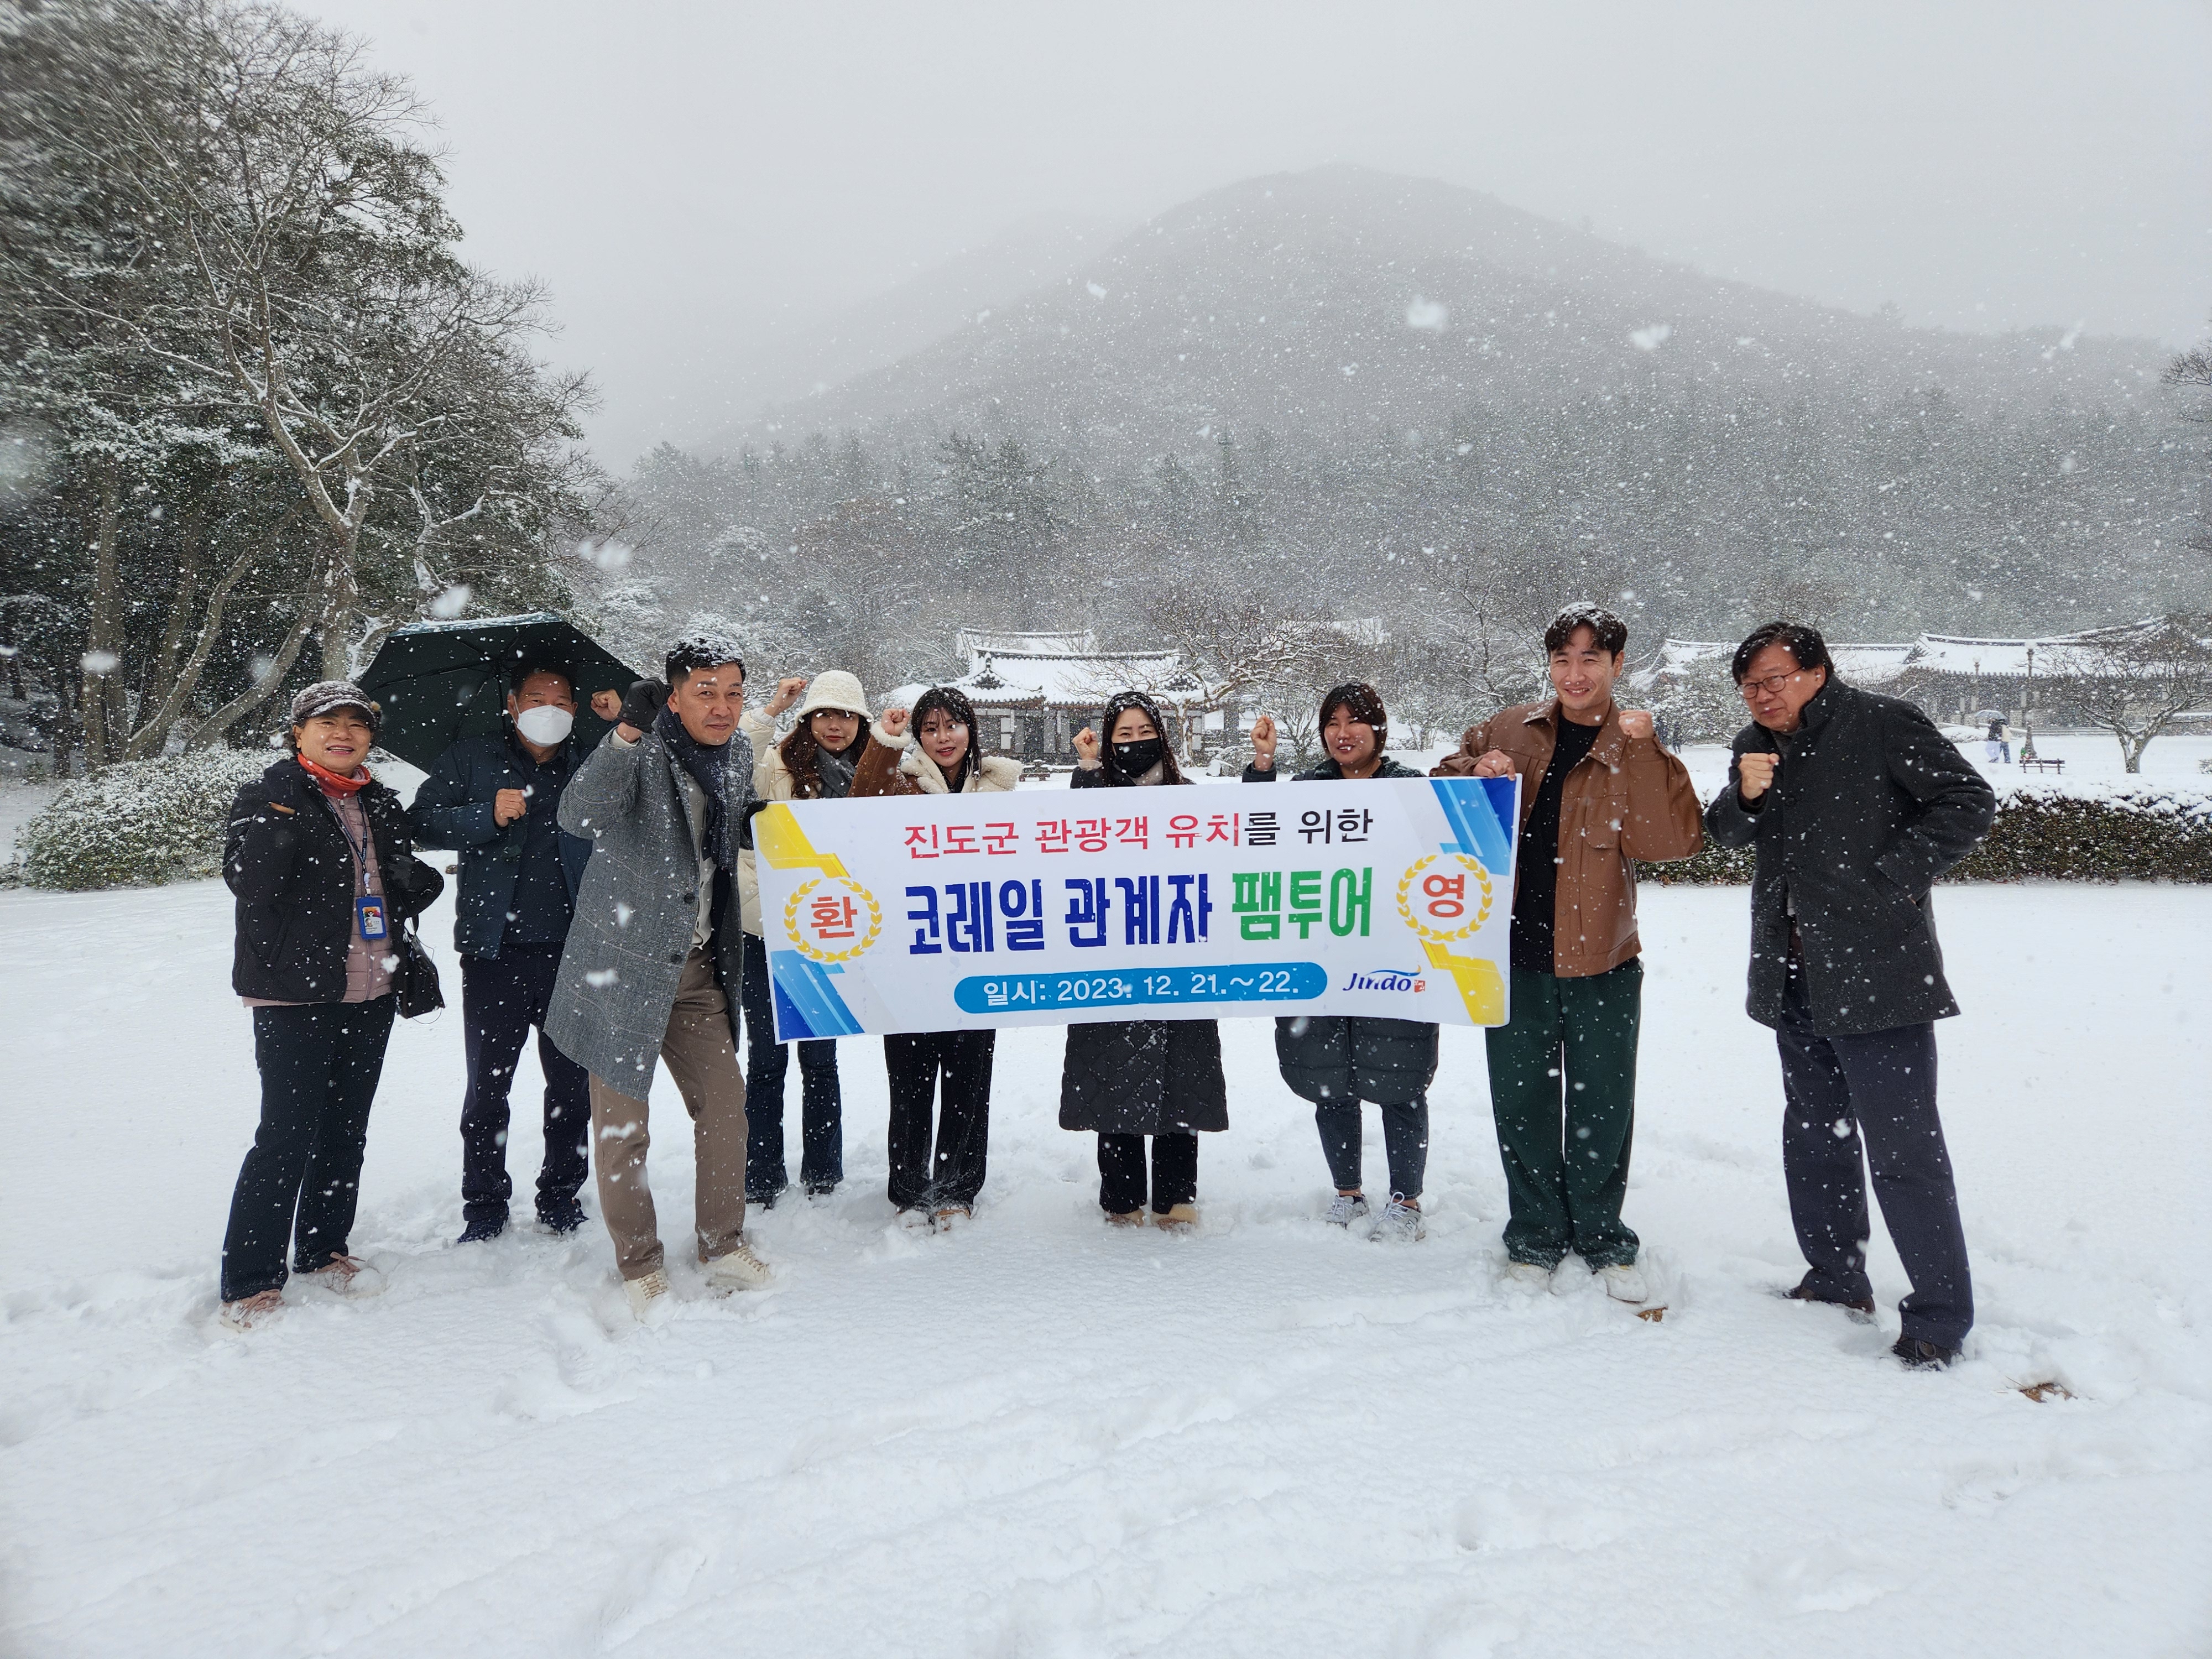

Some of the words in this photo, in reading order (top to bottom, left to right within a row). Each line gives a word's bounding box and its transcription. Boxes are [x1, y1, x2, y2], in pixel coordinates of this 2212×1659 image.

[904, 822, 1019, 859] 진도군
[1035, 816, 1148, 853] 관광객
[1165, 812, 1280, 848] 유치를
[1298, 808, 1373, 844] 위한
[810, 896, 858, 939] 환
[905, 879, 1045, 954] 코레일
[1065, 874, 1213, 948] 관계자
[1232, 867, 1372, 940] 팸투어
[1423, 874, 1465, 918] 영
[983, 980, 1046, 1006] 일시:
[1057, 978, 1132, 1001] 2023.
[1144, 975, 1179, 996] 12.
